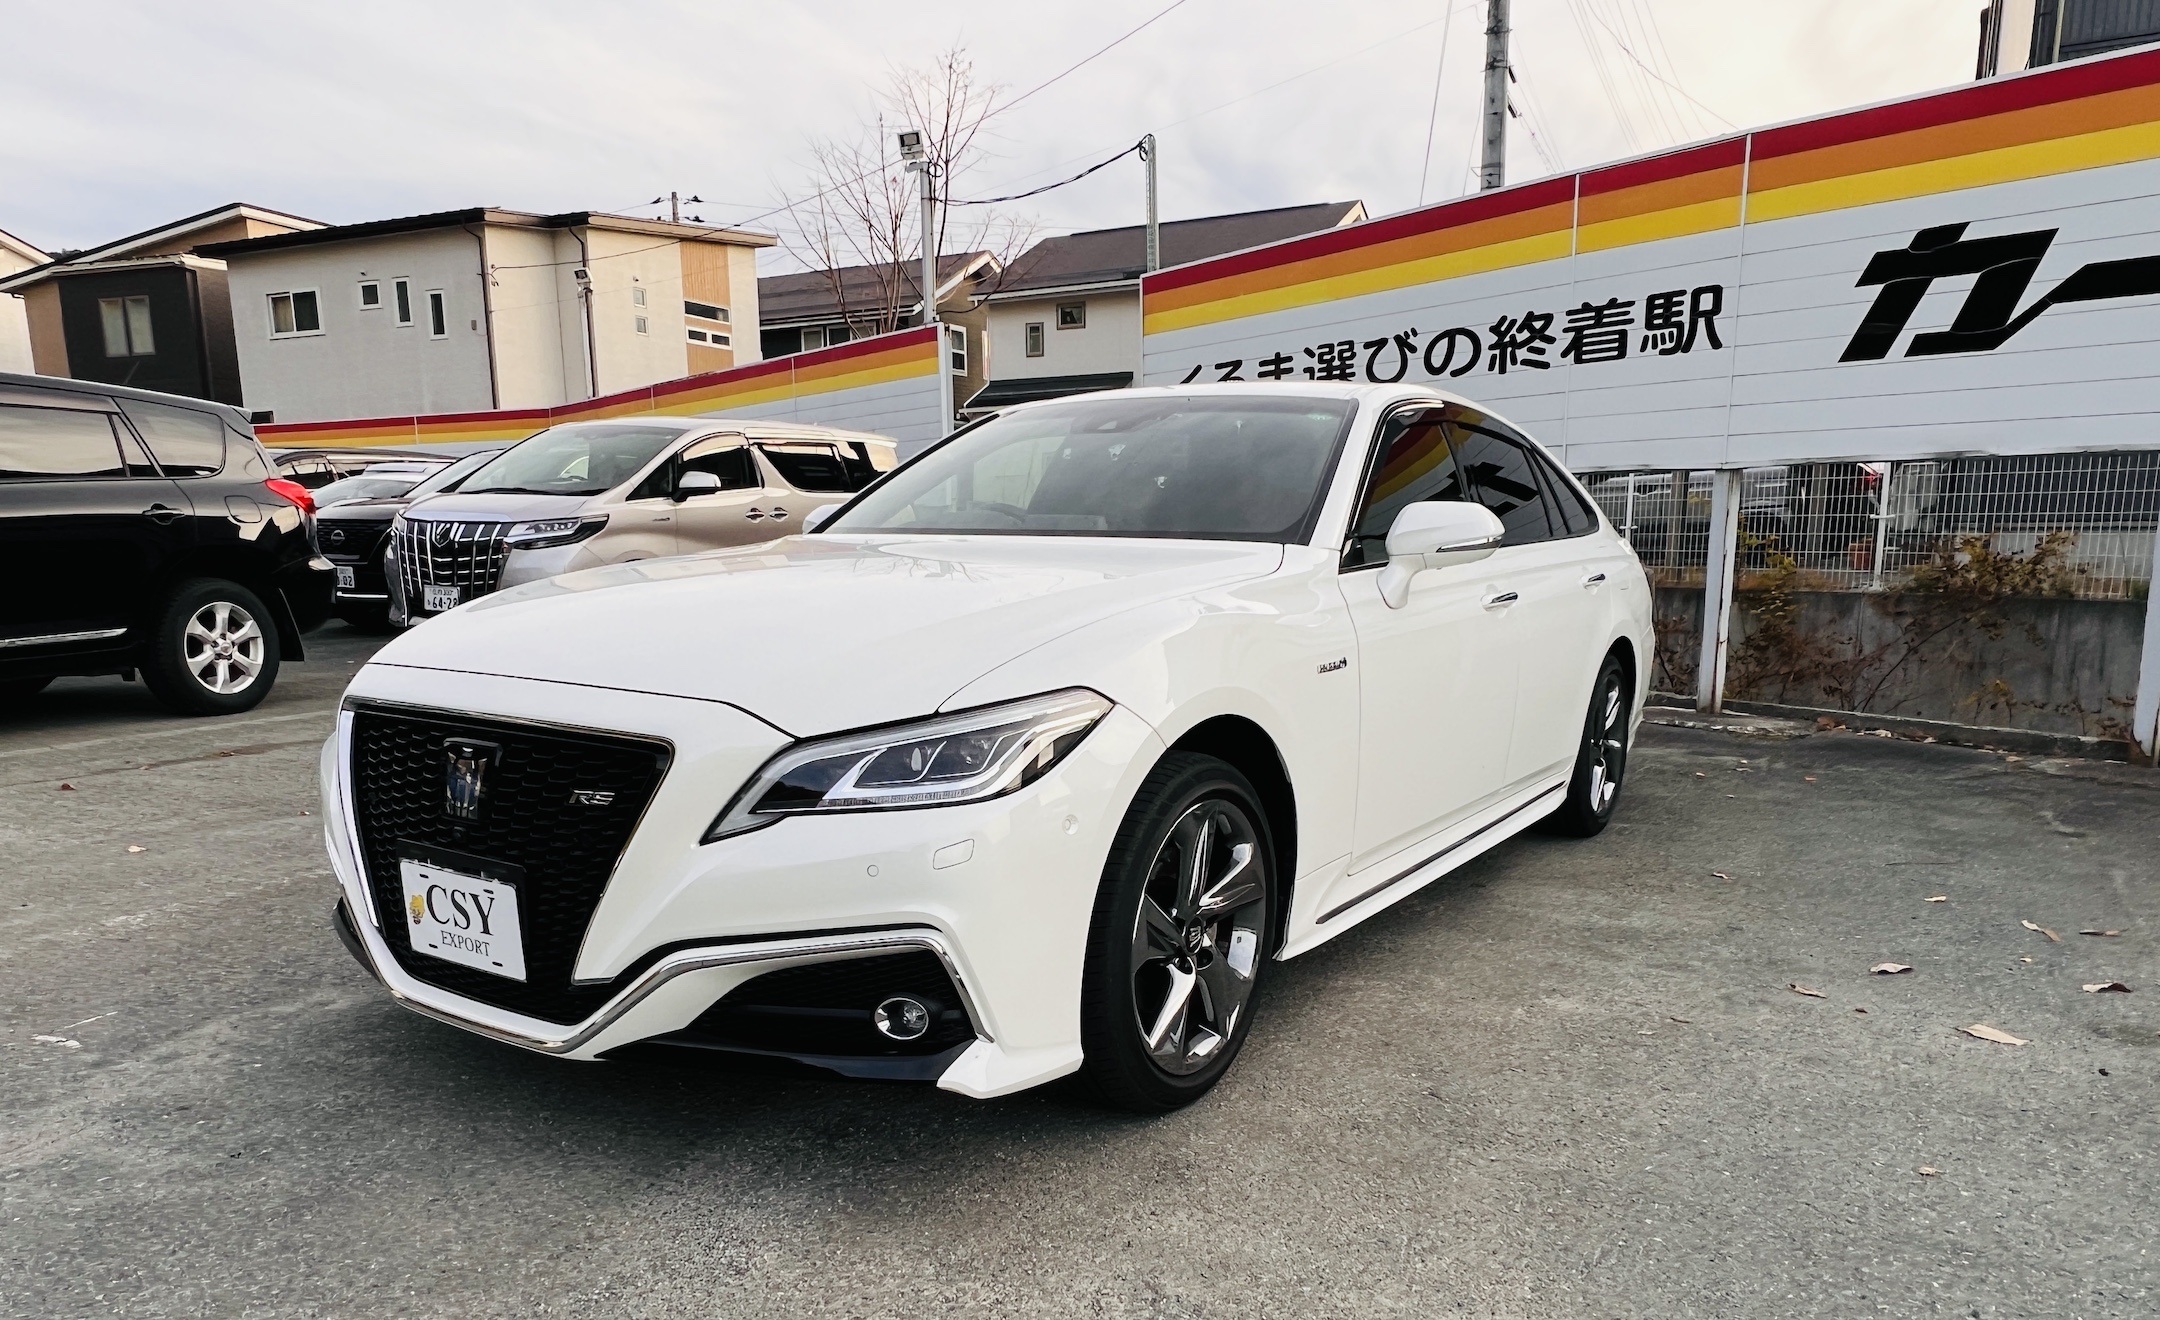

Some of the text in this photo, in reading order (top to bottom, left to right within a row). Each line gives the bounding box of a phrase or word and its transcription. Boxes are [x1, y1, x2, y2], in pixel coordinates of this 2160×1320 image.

[569, 789, 616, 806] RS
[426, 884, 495, 936] CSY
[440, 930, 490, 957] EXPORT
